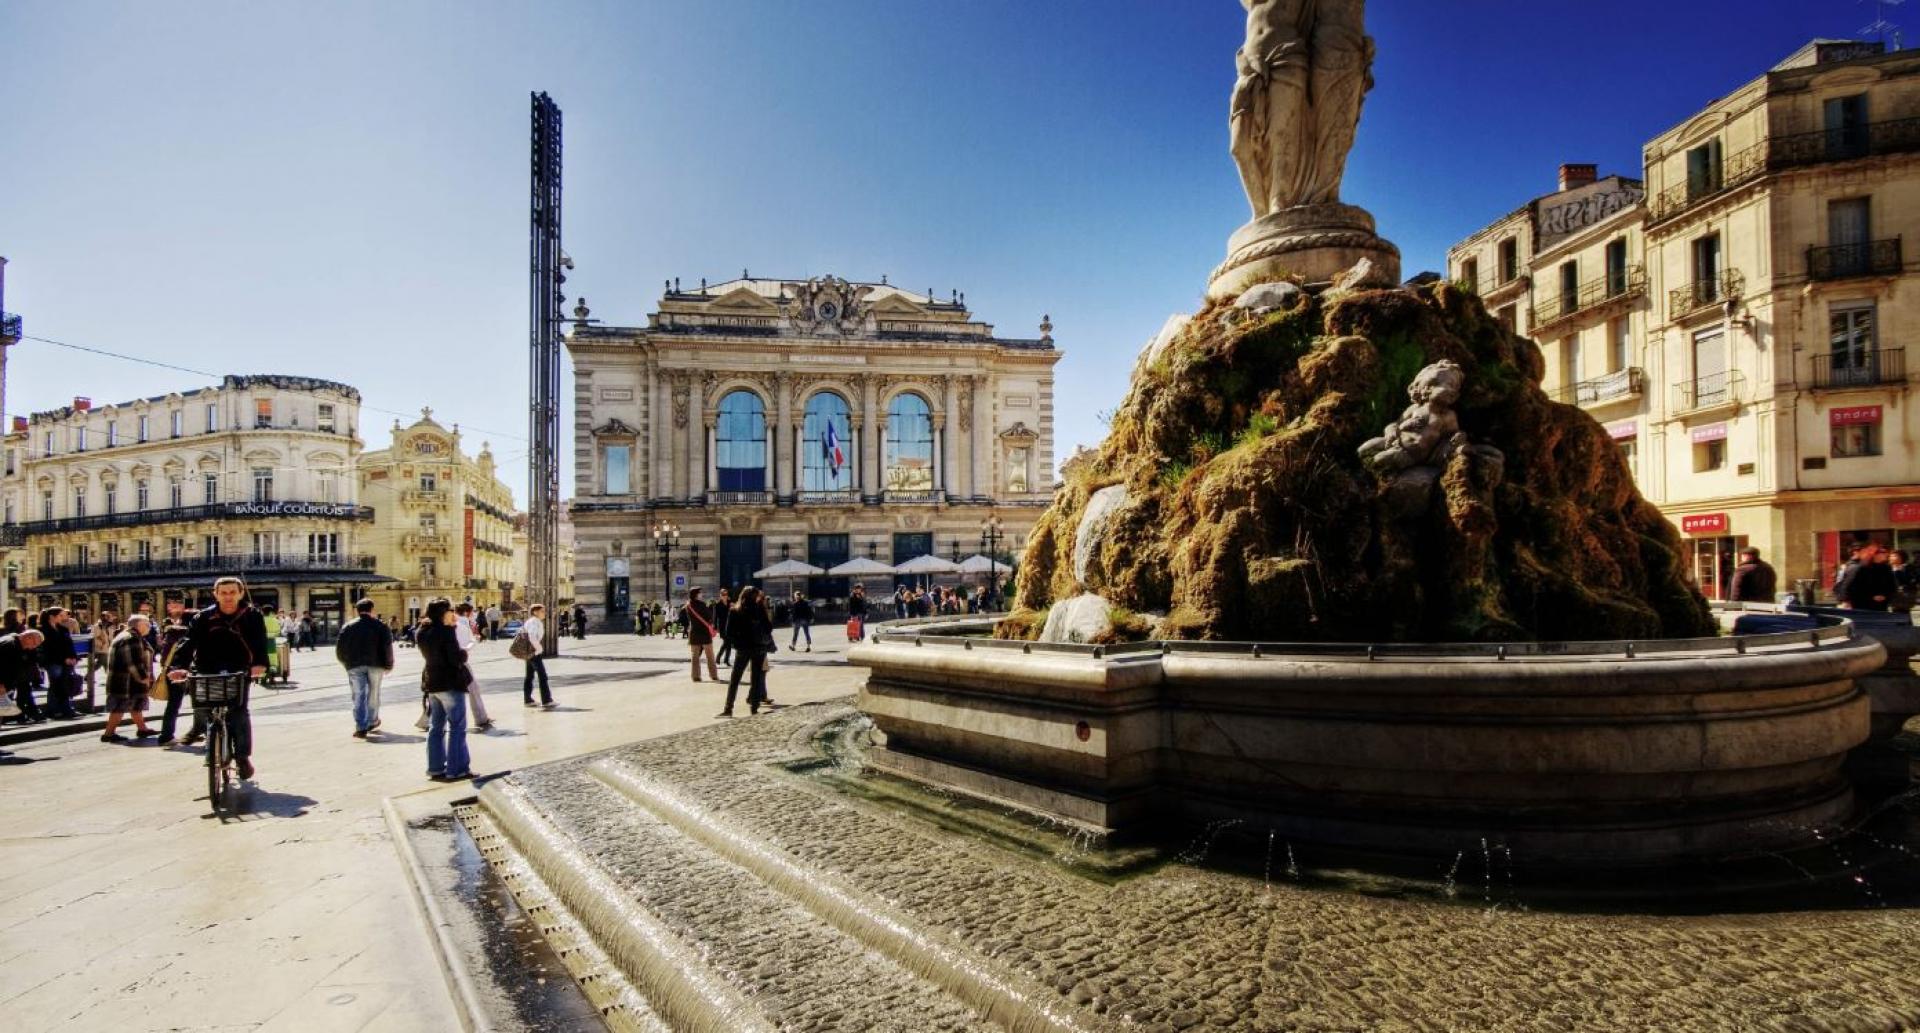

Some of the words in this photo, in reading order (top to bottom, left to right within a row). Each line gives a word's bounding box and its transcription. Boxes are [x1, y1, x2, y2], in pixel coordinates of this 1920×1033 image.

[1834, 408, 1877, 422] andré
[235, 504, 282, 515] BANQUE
[283, 504, 346, 516] COURTOIS
[1685, 516, 1720, 531] andré
